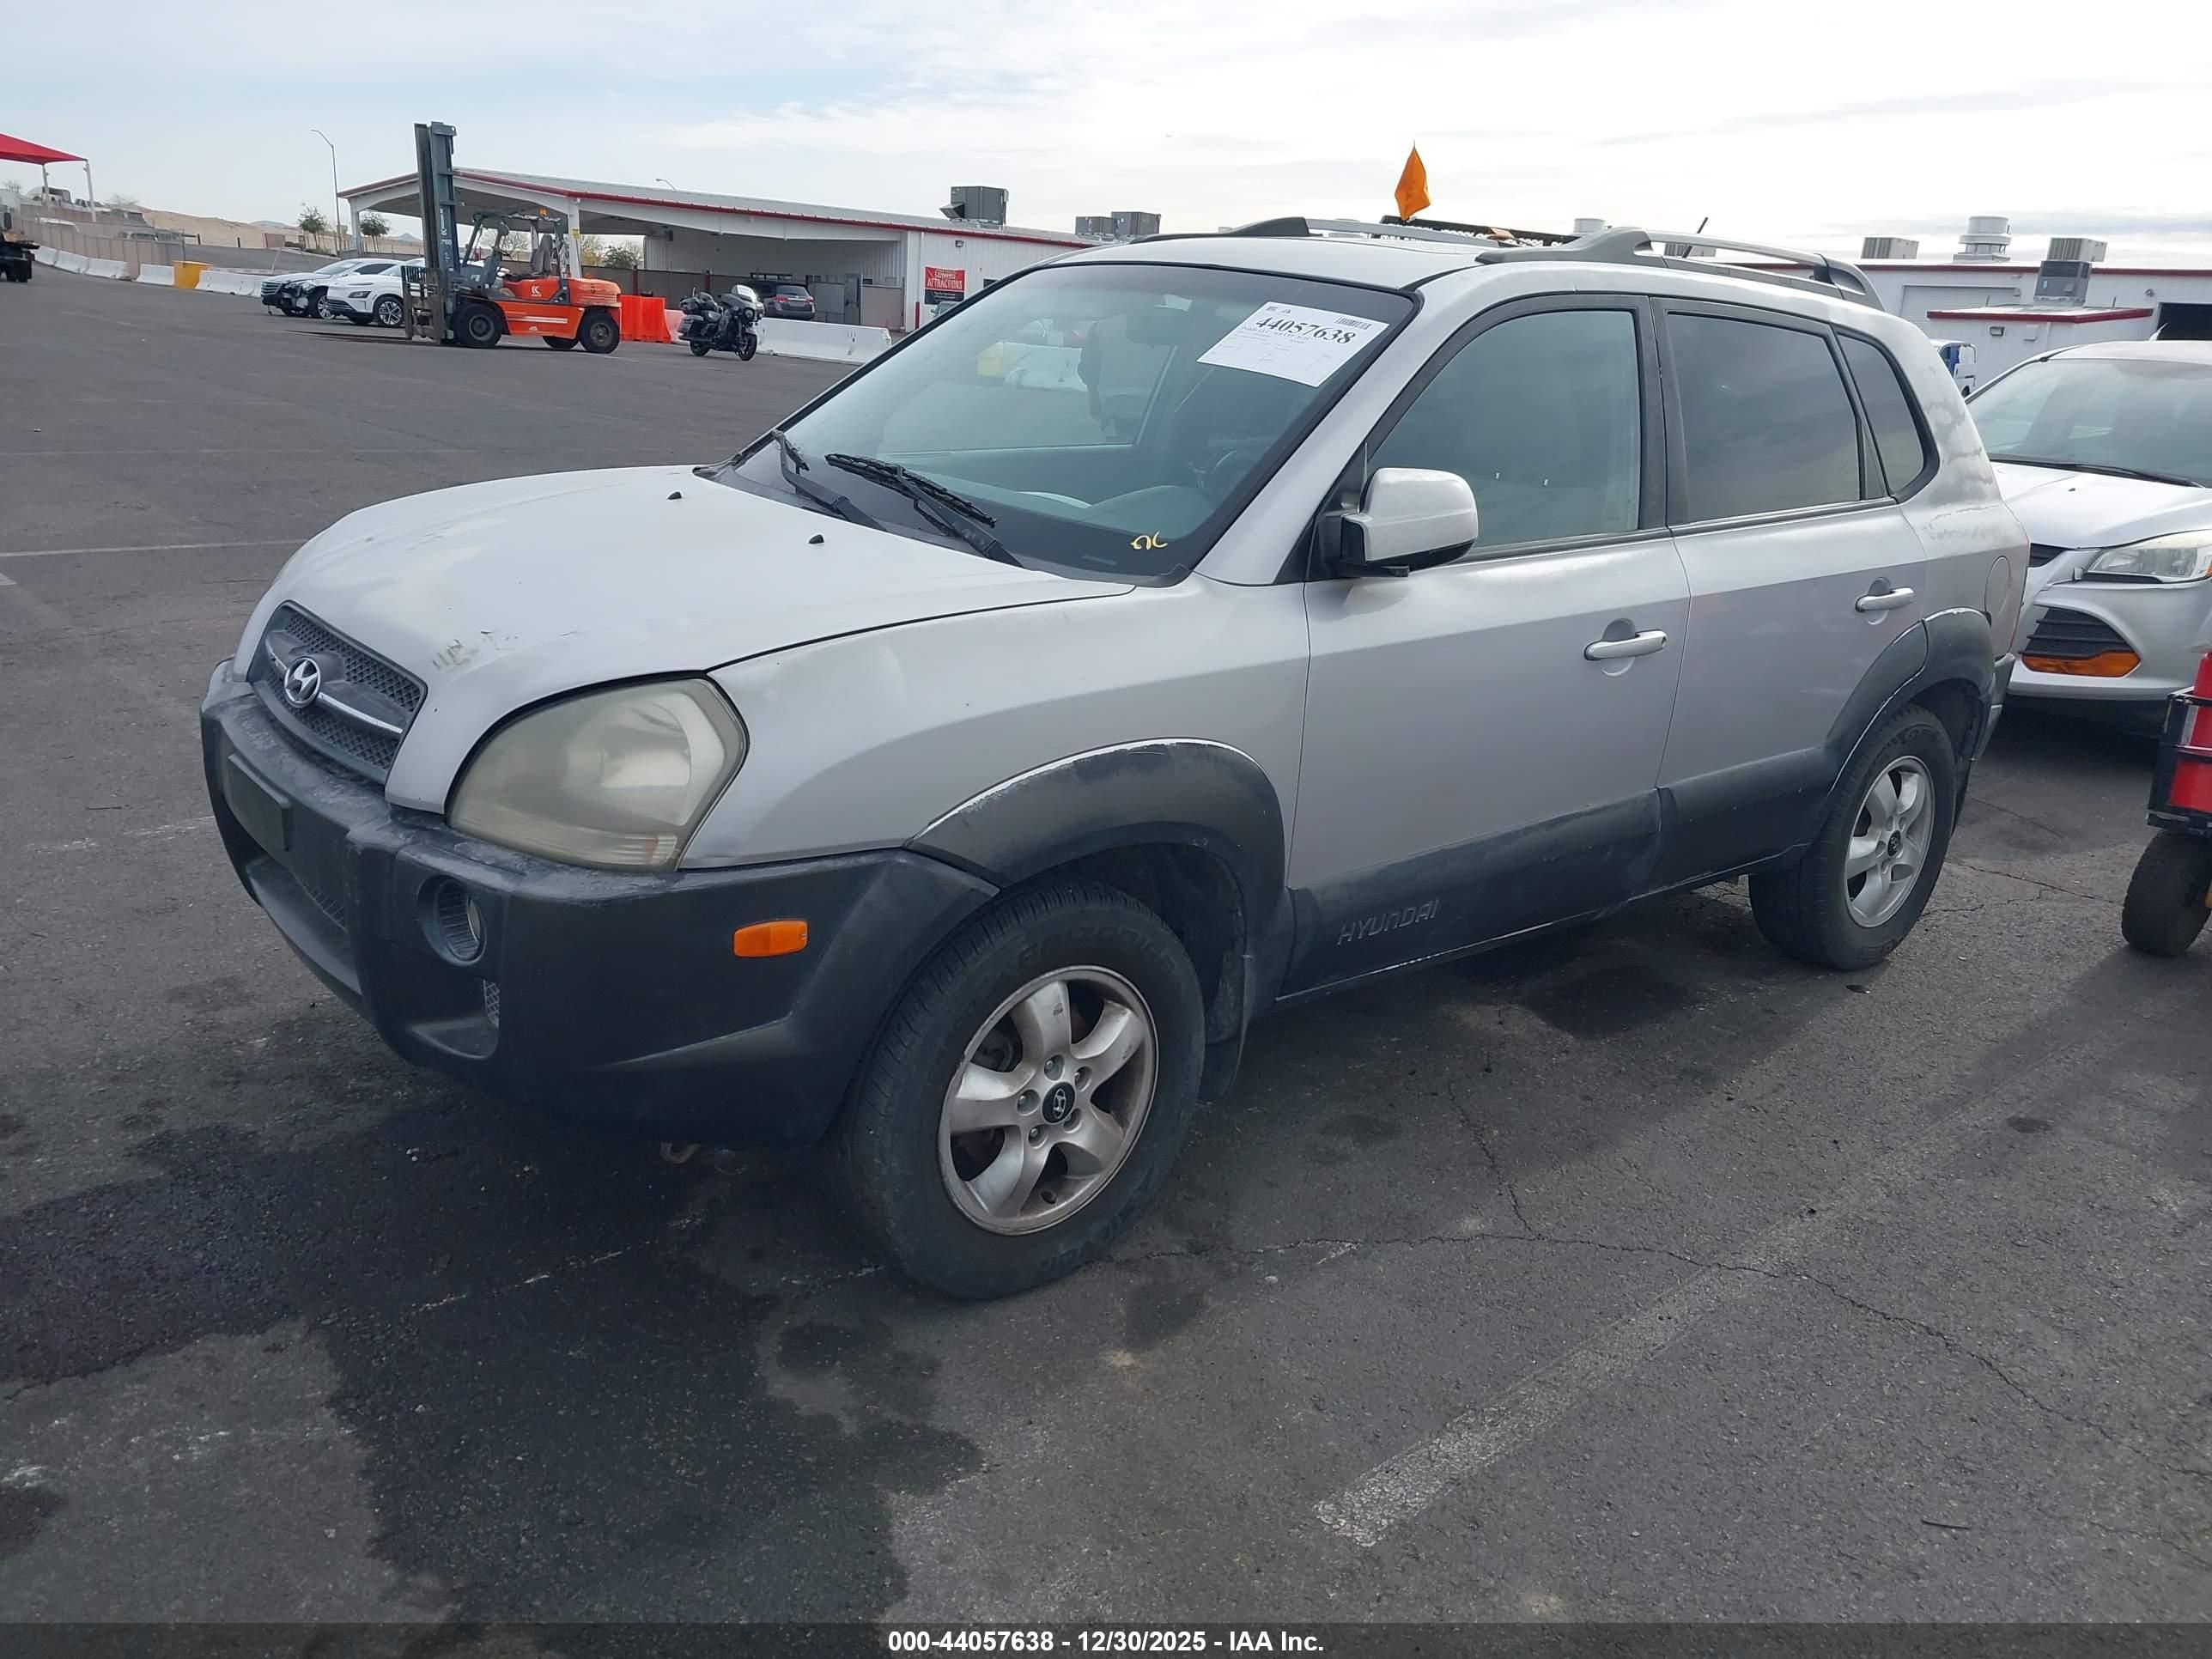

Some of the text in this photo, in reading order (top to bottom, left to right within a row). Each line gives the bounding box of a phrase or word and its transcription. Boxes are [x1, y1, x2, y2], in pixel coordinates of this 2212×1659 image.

[927, 277, 962, 289] ATTRACTIONS
[1255, 317, 1357, 344] 44057638
[1336, 899, 1440, 945] HYUNDAI
